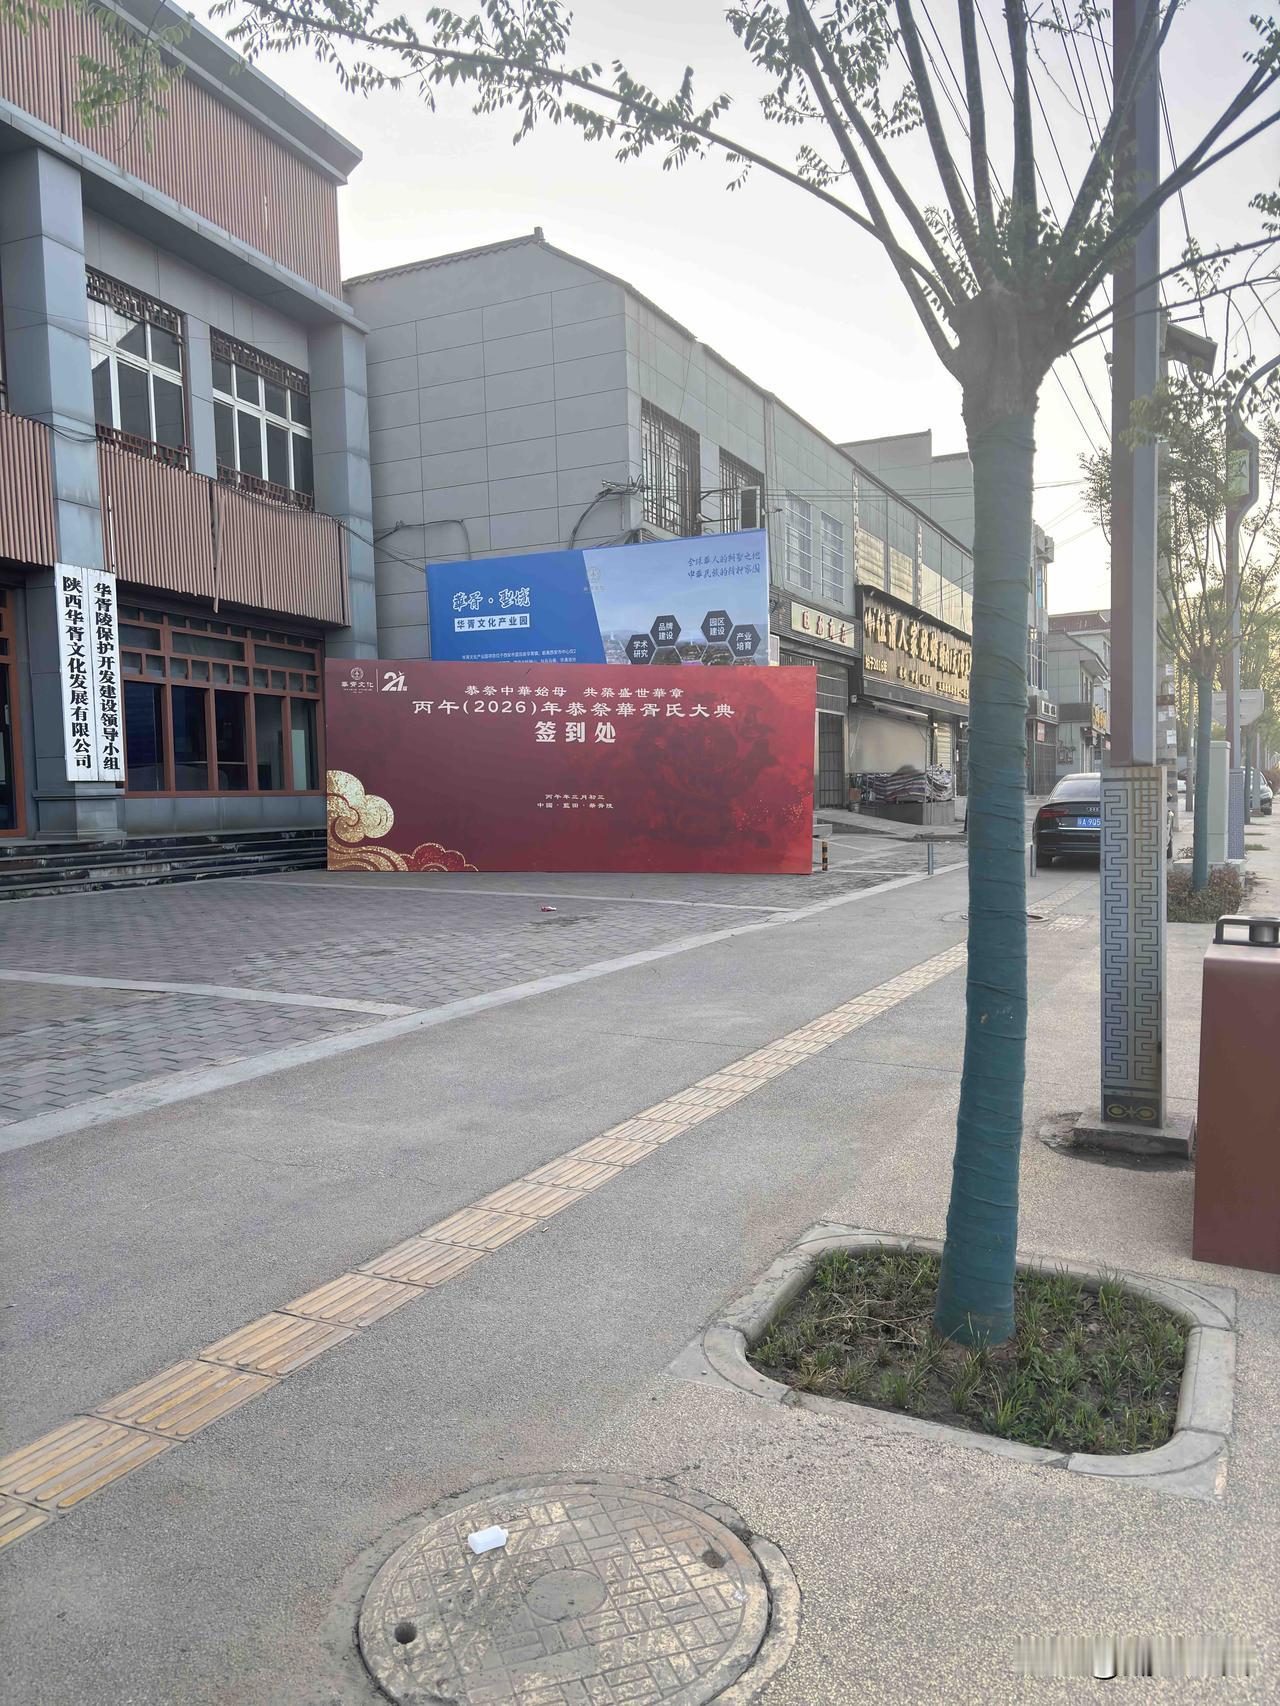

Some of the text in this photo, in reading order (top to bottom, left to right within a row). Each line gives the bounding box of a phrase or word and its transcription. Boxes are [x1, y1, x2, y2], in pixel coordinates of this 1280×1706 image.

[456, 615, 529, 631] 华胥文化产业园
[658, 622, 673, 632] 品牌
[709, 617, 725, 627] 园区
[658, 631, 674, 641] 建设
[709, 626, 725, 636] 建设
[736, 631, 752, 641] 产业
[633, 640, 648, 649] 学术
[736, 640, 752, 651] 培育
[633, 648, 648, 658] 研究
[62, 576, 92, 769] 陕西华胥文化发展有限公司
[94, 582, 120, 770] 华胥陵保护开发建设领导小组
[464, 685, 567, 697] 恭祭中華始母
[412, 700, 735, 718] 丙午(2026)年恭祭華胥氏大典
[535, 721, 616, 743] 签到处
